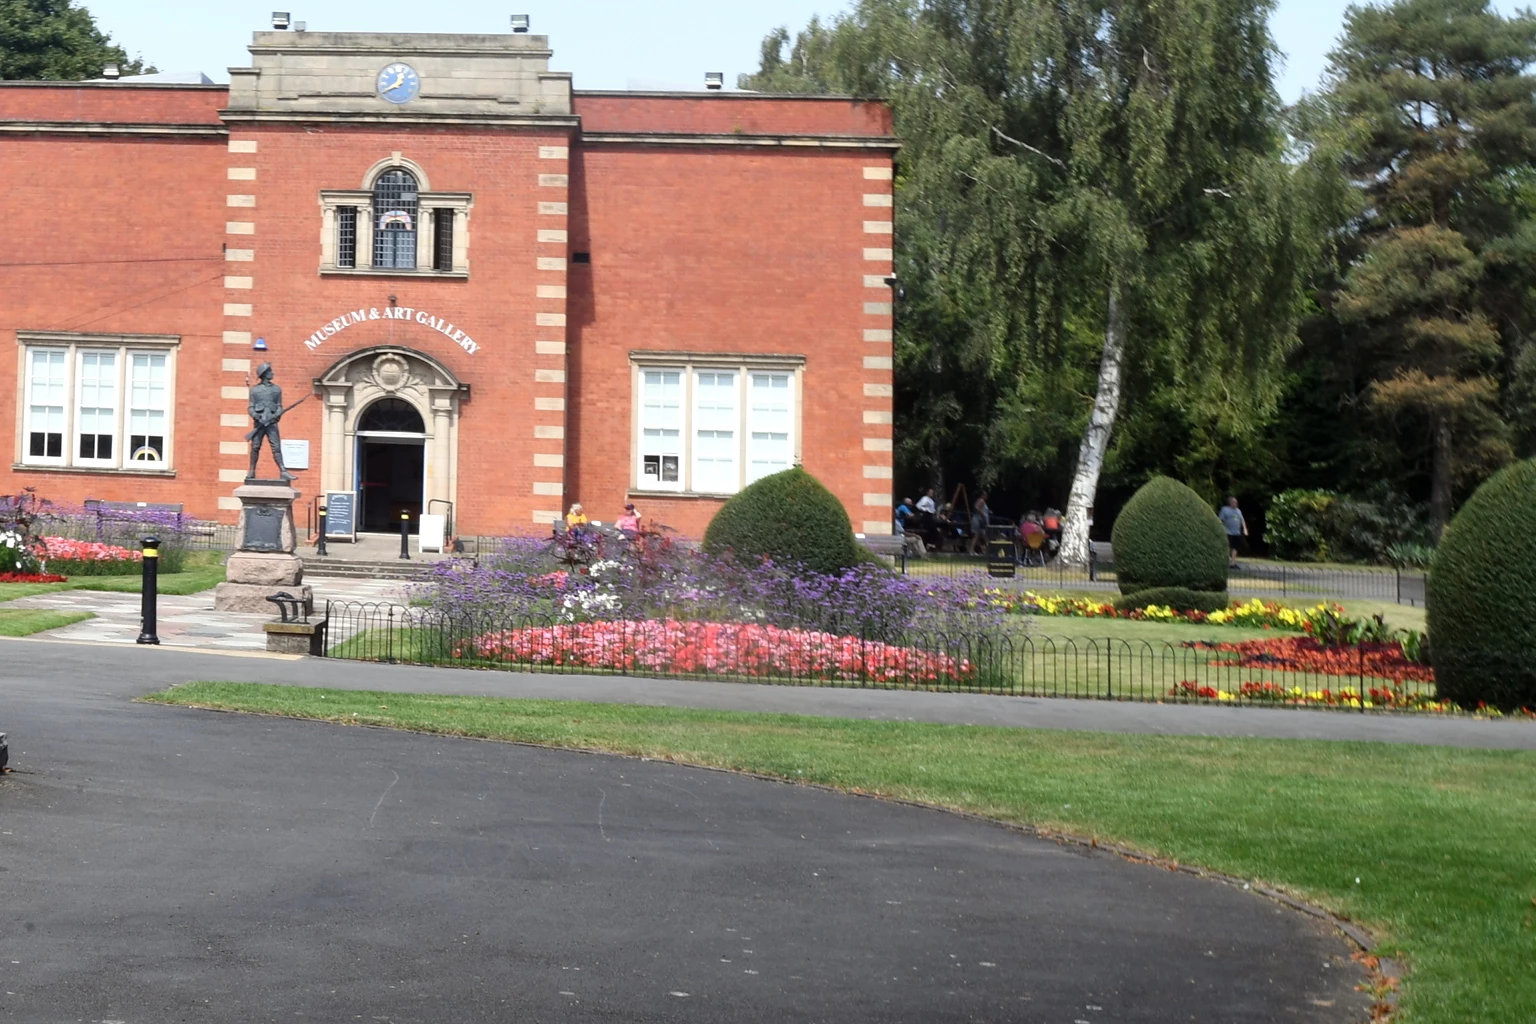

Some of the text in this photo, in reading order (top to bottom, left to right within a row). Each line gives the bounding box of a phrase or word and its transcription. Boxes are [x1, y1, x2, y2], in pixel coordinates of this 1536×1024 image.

[304, 306, 481, 355] MUSEUM & ART GALLERY
